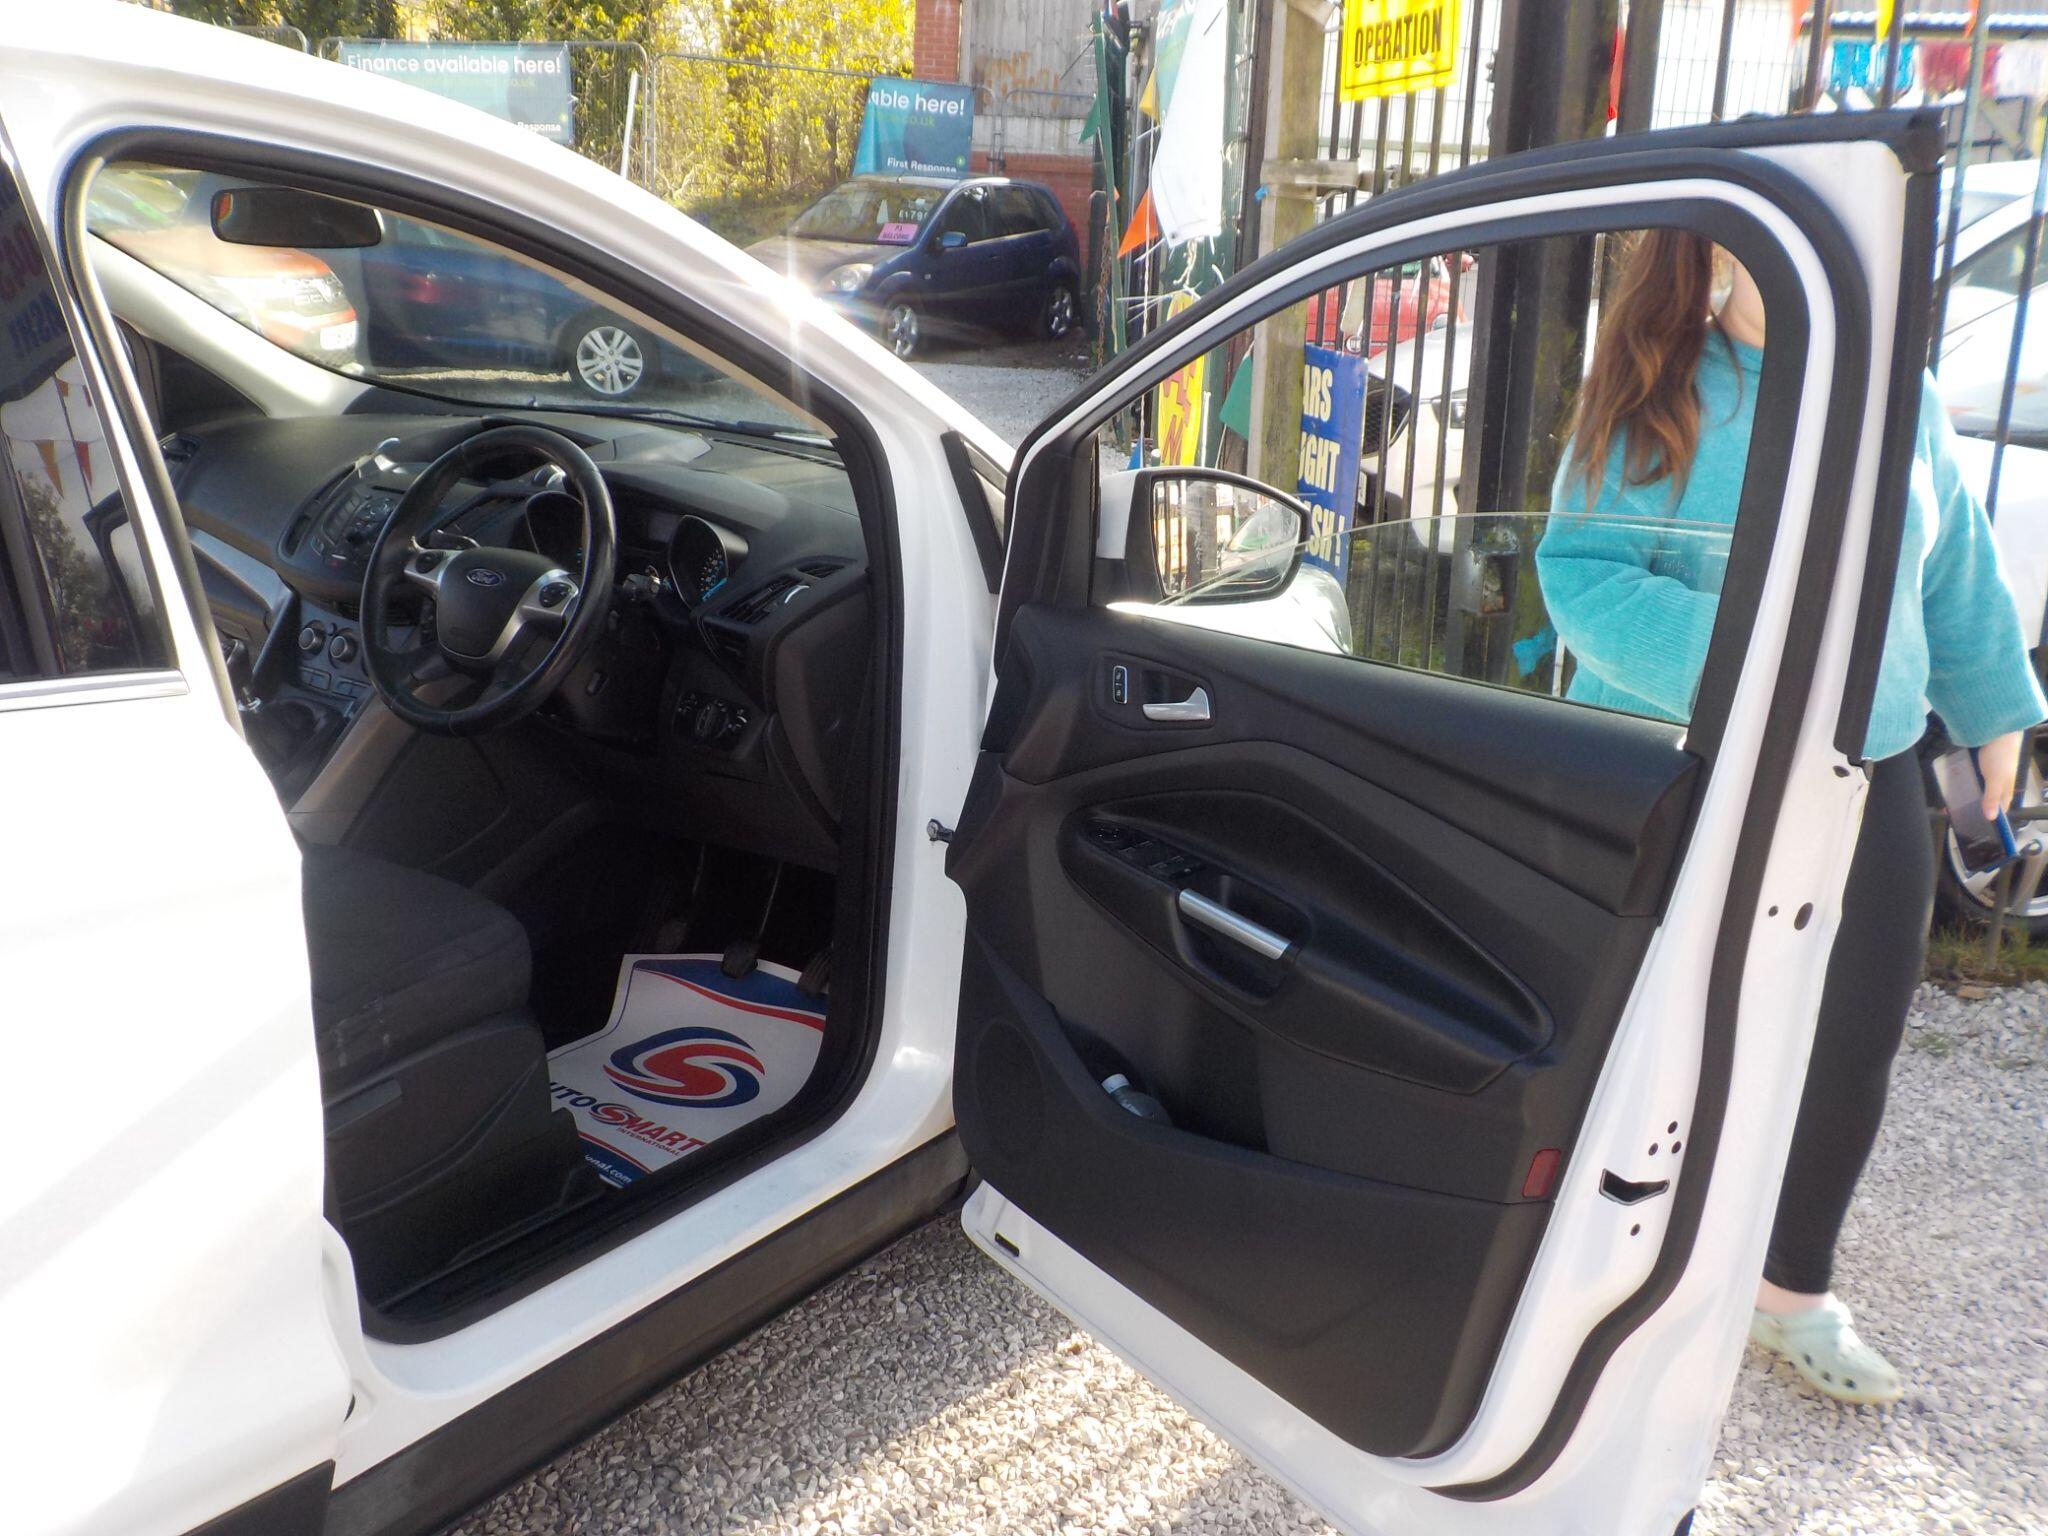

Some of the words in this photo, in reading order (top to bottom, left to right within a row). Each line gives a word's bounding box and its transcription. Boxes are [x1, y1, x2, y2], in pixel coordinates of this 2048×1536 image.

[1354, 7, 1442, 68] OPERATION
[348, 55, 418, 73] Finance
[424, 55, 508, 73] available
[513, 56, 561, 73] here!
[915, 93, 965, 116] here!
[887, 157, 909, 169] First
[616, 1127, 681, 1156] INTERNATIONAL
